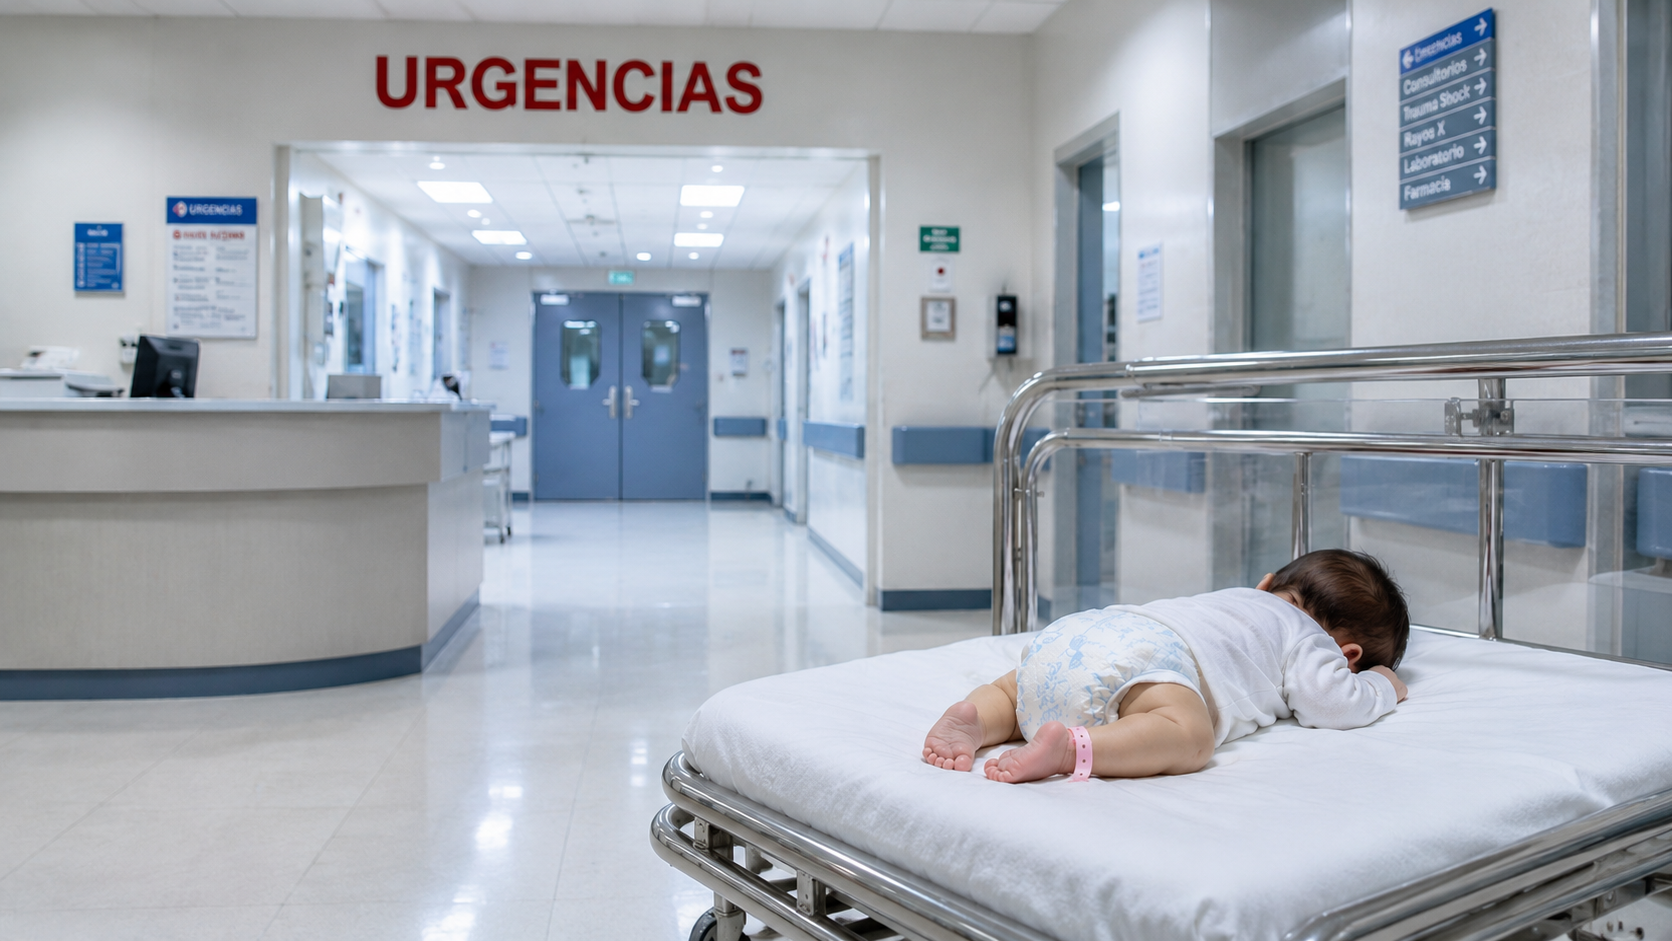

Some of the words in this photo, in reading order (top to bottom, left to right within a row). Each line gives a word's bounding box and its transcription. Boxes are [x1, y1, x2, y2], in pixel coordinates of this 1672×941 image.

[376, 55, 763, 114] URGENCIAS
[1403, 59, 1467, 95] Consultorios
[1403, 98, 1438, 121] Trauma
[1439, 84, 1470, 108] Shock
[1404, 127, 1435, 147] Rayos
[1437, 120, 1446, 136] X
[1404, 143, 1464, 174] Laboratorio
[1404, 175, 1451, 201] Farmacia
[189, 203, 243, 216] URGENCIAS
